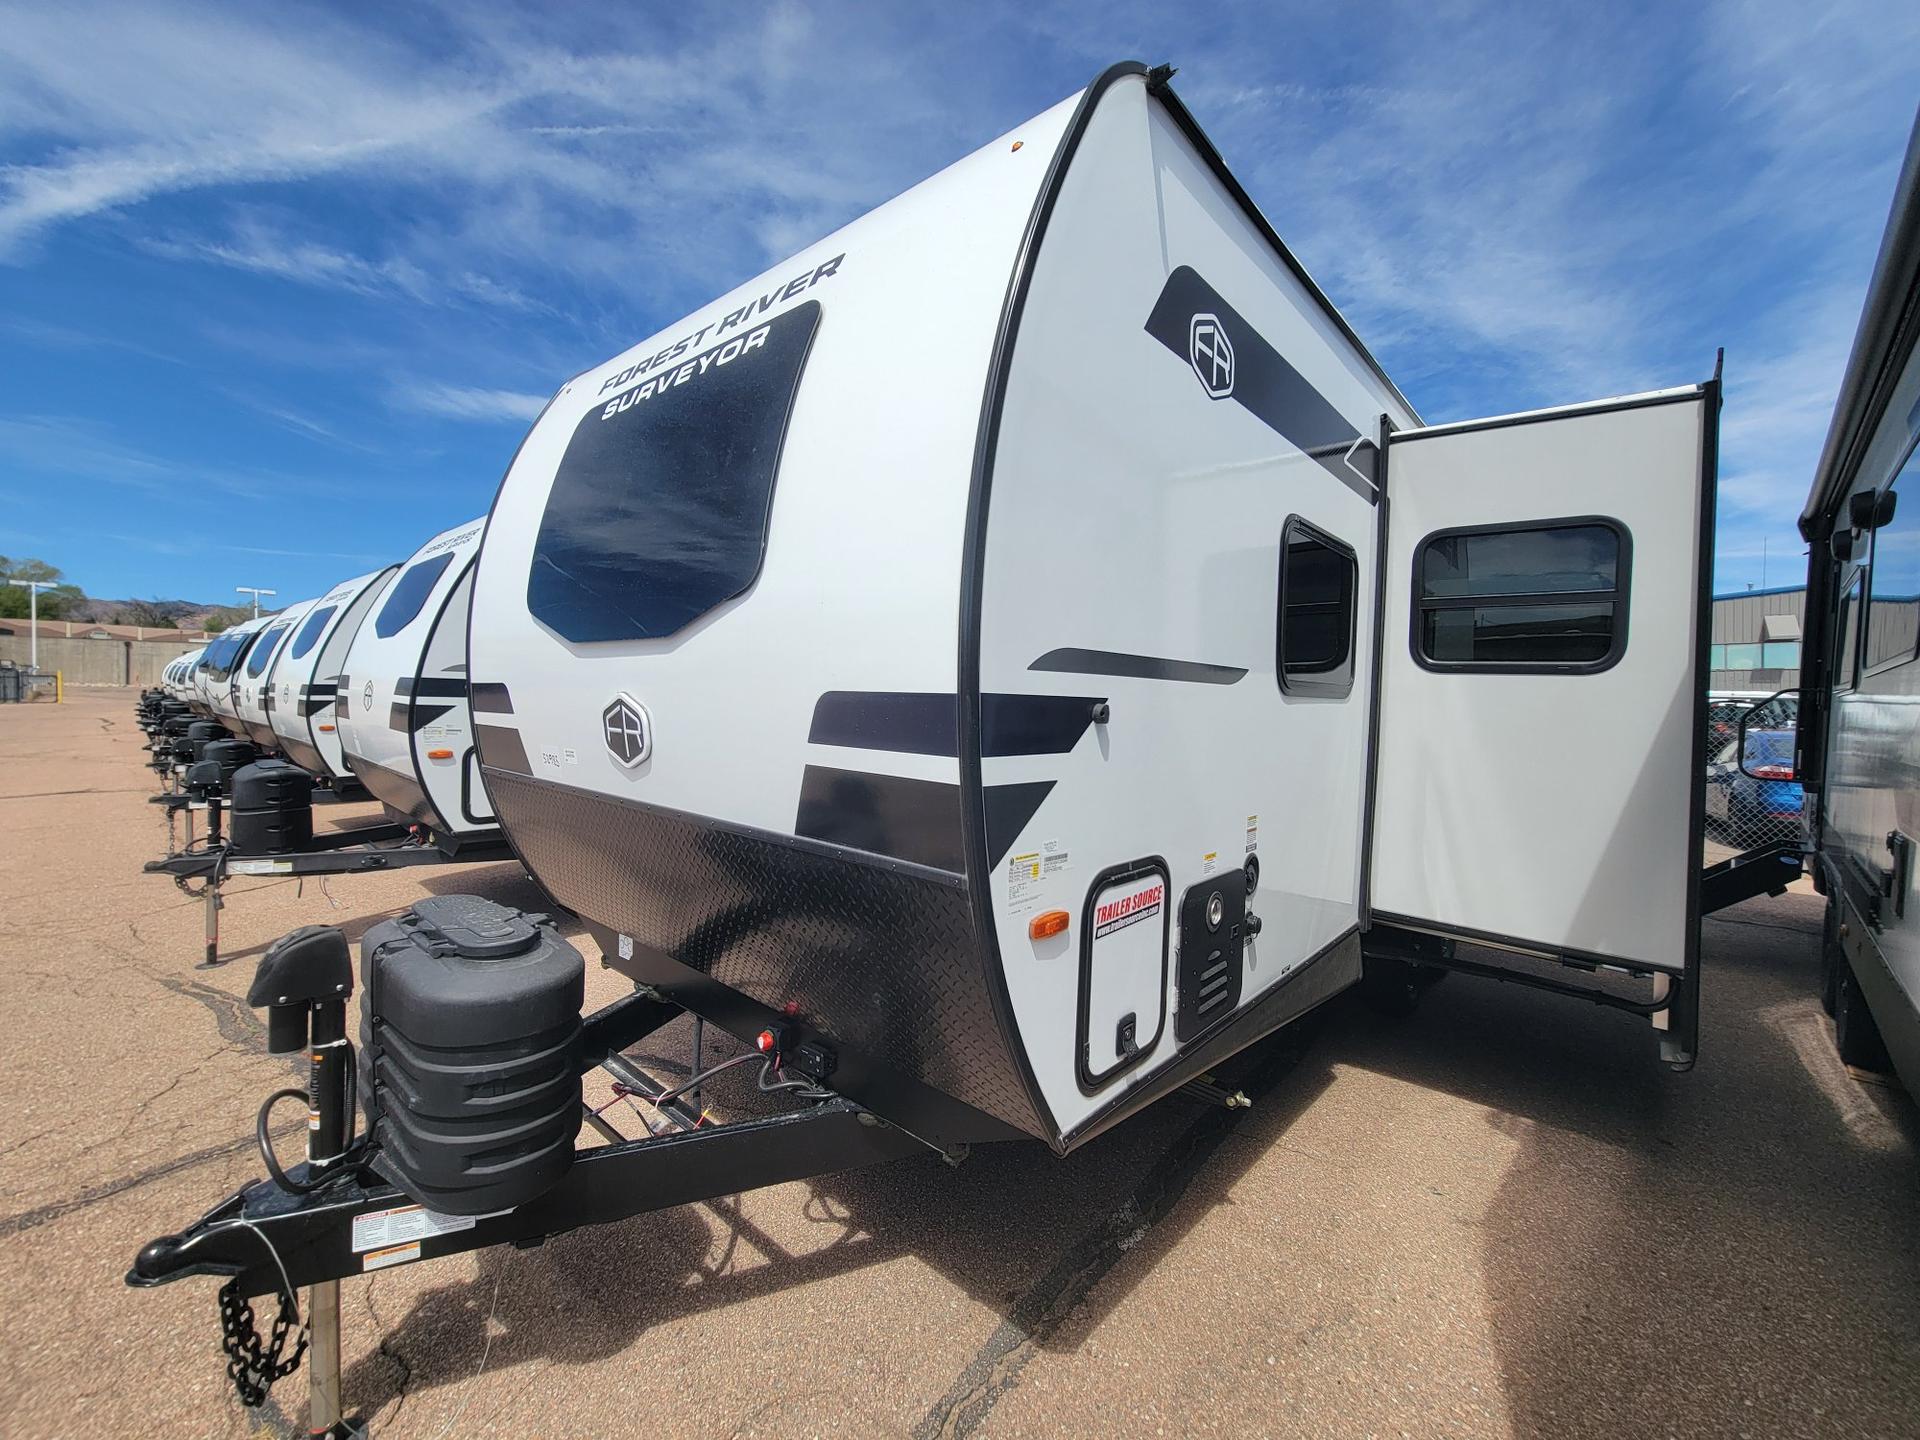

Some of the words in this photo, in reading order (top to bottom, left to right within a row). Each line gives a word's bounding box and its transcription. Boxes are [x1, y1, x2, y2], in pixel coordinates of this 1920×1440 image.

[598, 323, 715, 396] FOREST
[715, 253, 847, 336] RIVER
[601, 325, 771, 421] SURVEYOR
[1096, 896, 1132, 926] TRAILER
[1131, 884, 1163, 911] SOURCE
